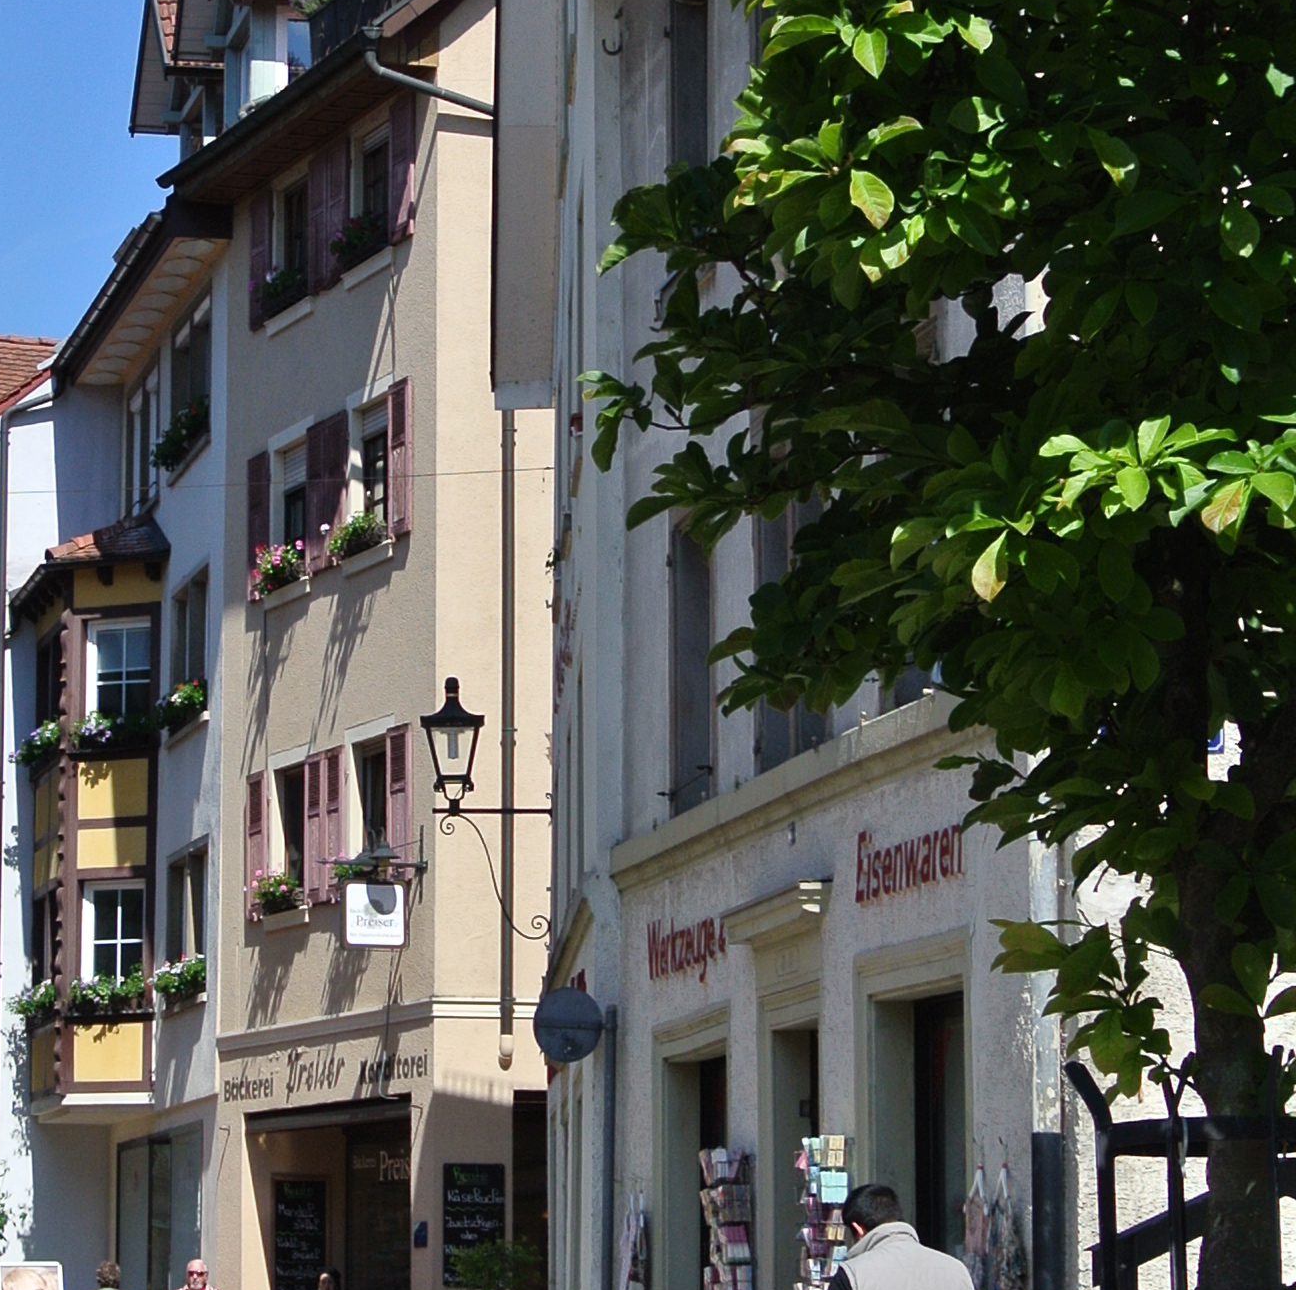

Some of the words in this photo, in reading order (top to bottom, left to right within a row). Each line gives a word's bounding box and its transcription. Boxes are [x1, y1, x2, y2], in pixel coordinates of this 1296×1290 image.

[854, 823, 963, 904] Eisenwaren
[356, 915, 394, 927] Preiser
[646, 917, 717, 984] Werkzeuge
[223, 1072, 274, 1103] Bäckerei
[359, 1049, 428, 1086] Konditorei
